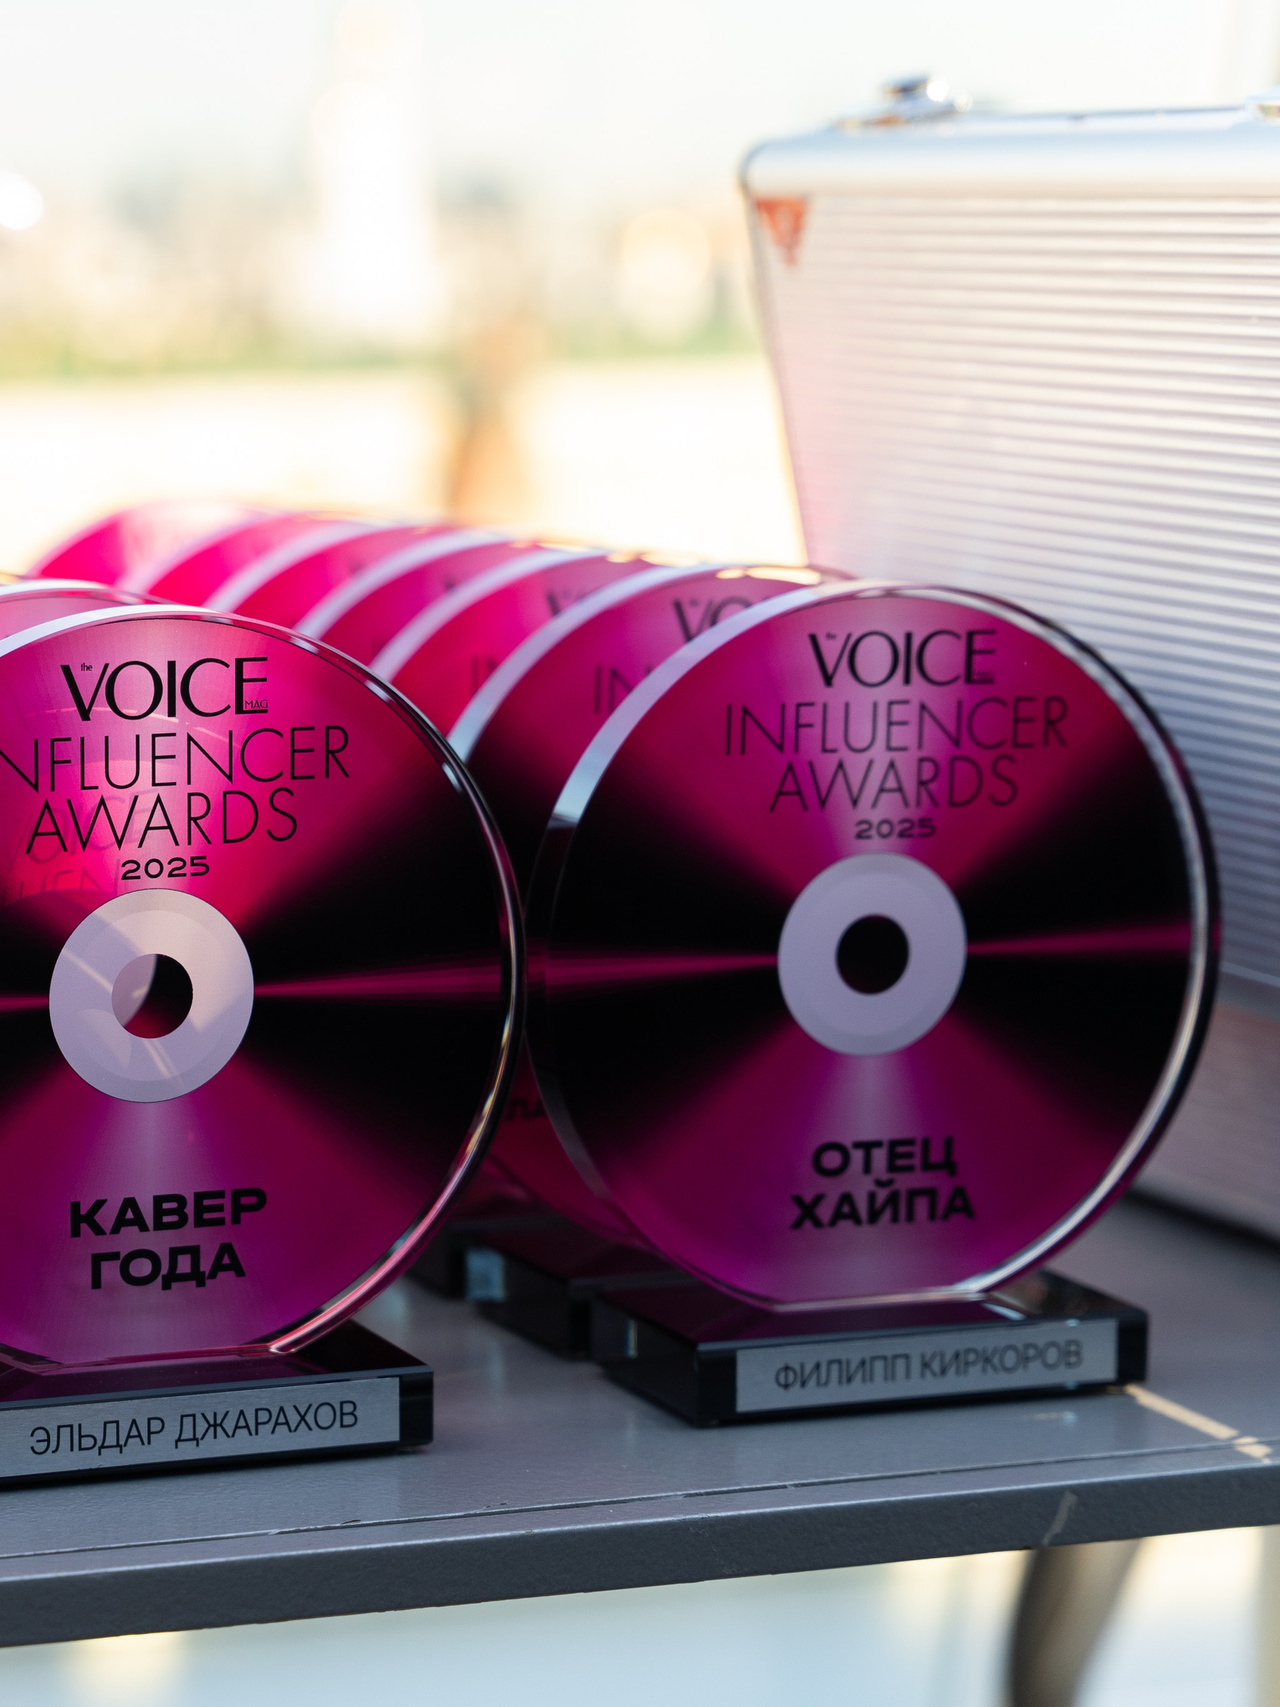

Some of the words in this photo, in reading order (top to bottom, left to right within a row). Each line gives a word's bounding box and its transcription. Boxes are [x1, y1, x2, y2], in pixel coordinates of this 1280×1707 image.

[80, 662, 93, 672] the
[808, 629, 996, 687] VOICE
[60, 656, 269, 721] VOICE
[244, 699, 269, 709] MAG
[725, 696, 1068, 755] INFLUENCER
[769, 754, 1018, 813] AWARDS
[25, 787, 298, 855] AWARDS
[855, 817, 936, 840] 2025
[120, 855, 210, 881] 2025
[812, 1135, 957, 1178] ОТЕЦ
[69, 1187, 267, 1239] КАВЕР
[789, 1178, 976, 1231] ХАЙПА
[90, 1242, 246, 1291] ГОДА
[775, 1354, 910, 1392] ФИЛИПП
[921, 1339, 1083, 1380] КИРКОРОВ
[29, 1416, 166, 1456] ЭЛЬДАР
[175, 1400, 359, 1449] ДЖАРАХОВ
